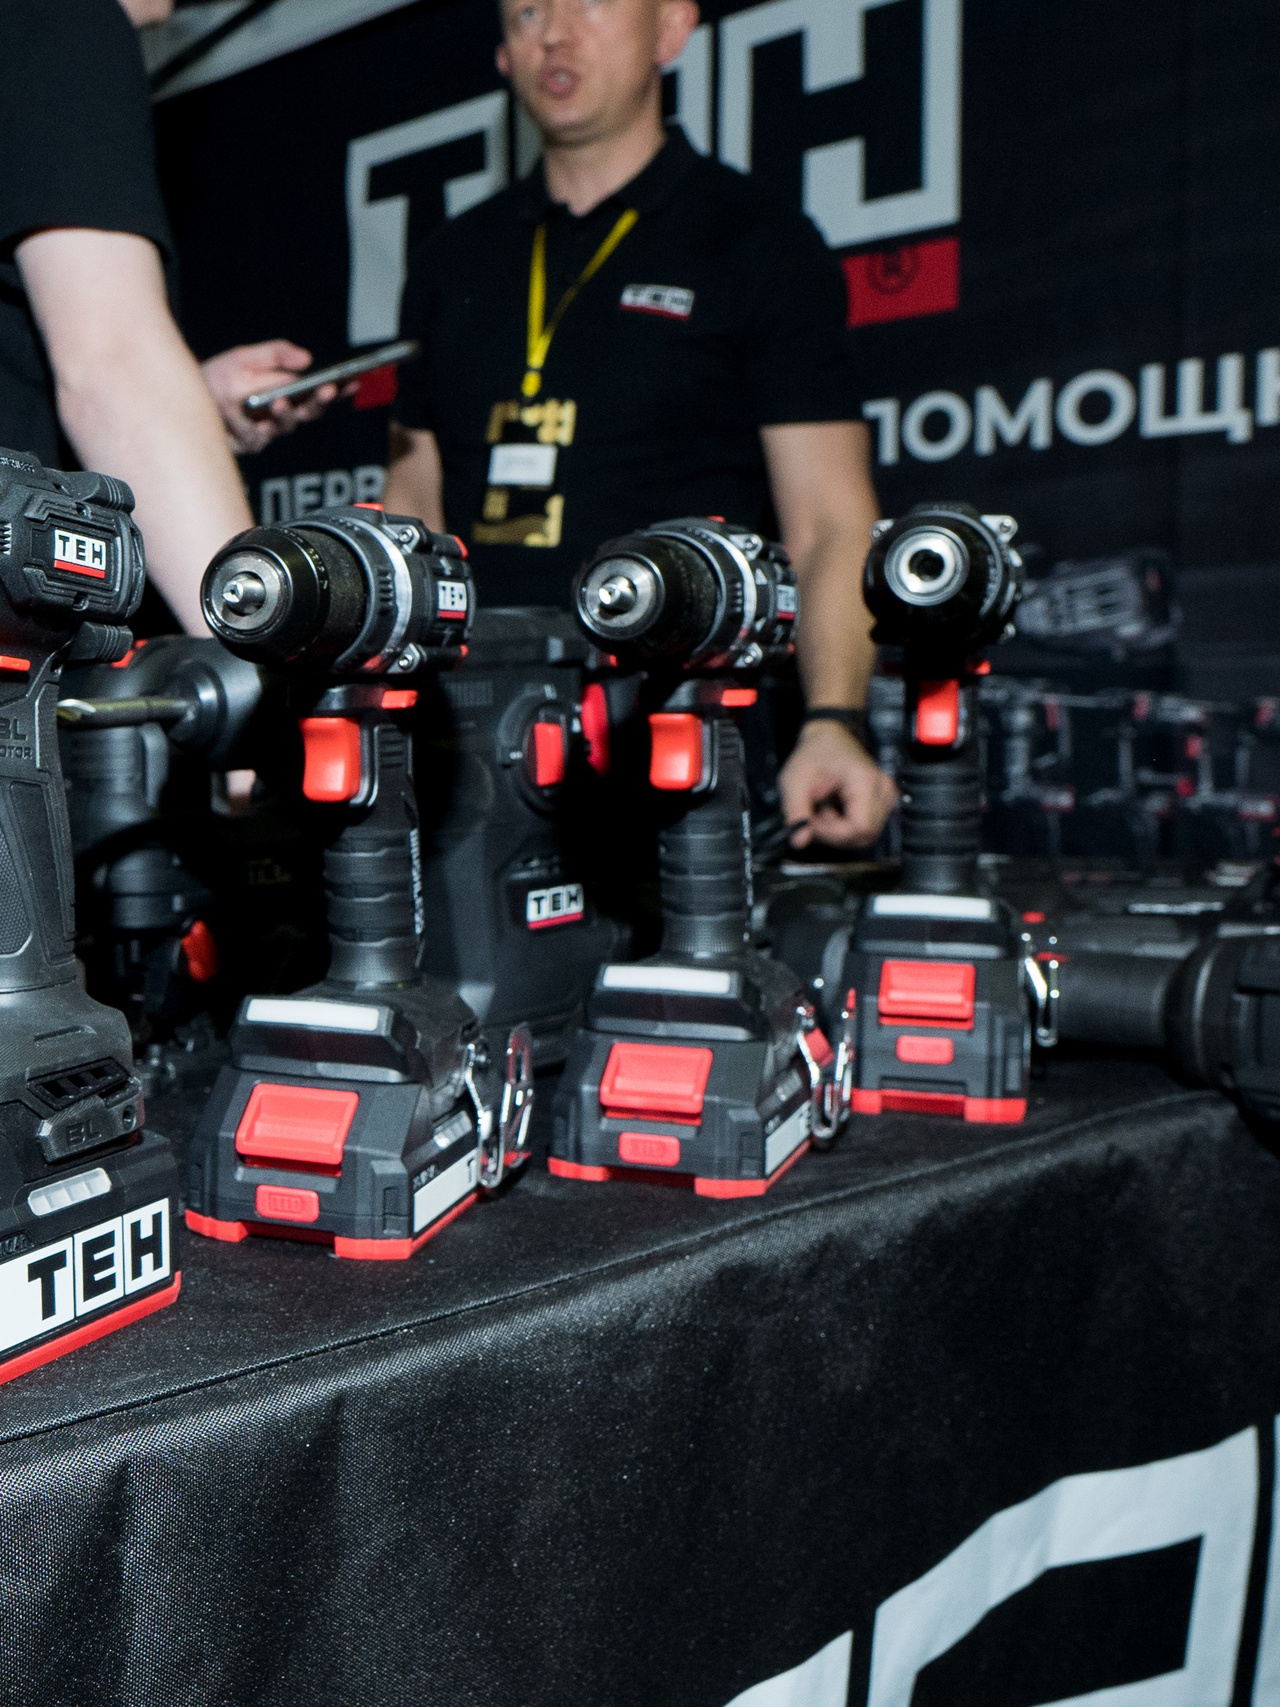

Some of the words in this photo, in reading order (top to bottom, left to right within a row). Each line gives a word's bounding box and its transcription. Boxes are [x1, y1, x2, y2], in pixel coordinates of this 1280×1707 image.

[56, 534, 106, 569] TEH
[531, 890, 583, 916] TEH
[26, 1210, 165, 1322] TEH
